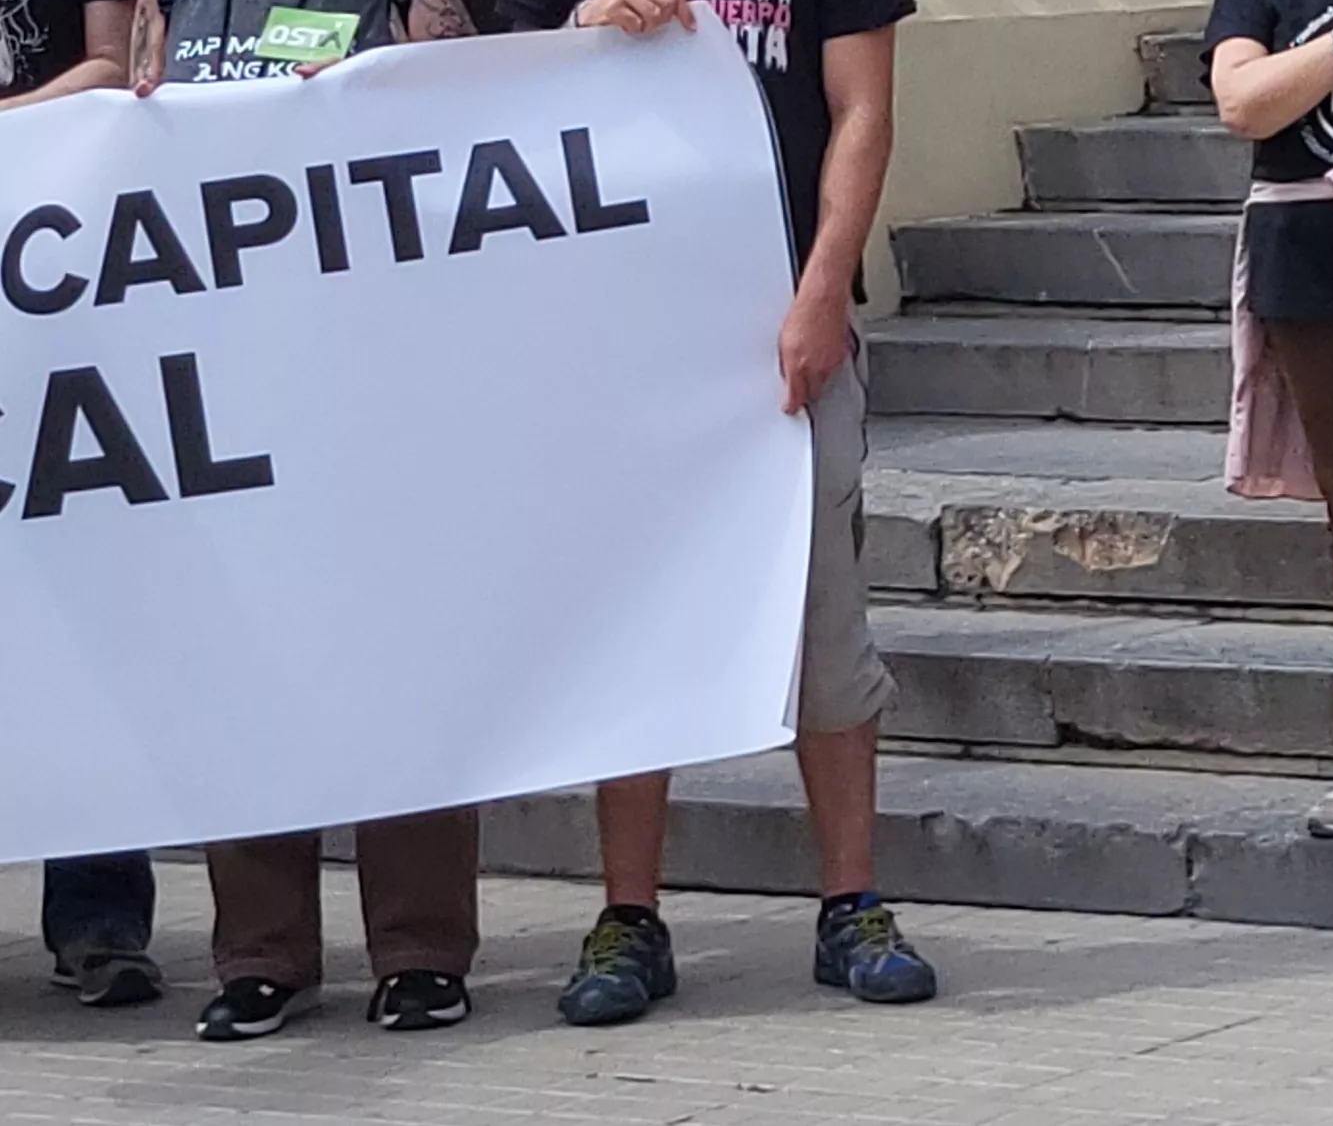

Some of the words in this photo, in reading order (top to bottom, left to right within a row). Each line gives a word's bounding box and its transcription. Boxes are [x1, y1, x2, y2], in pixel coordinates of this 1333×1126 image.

[175, 36, 221, 61] RAP
[0, 126, 650, 316] CAPITAL
[0, 351, 275, 520] AL
